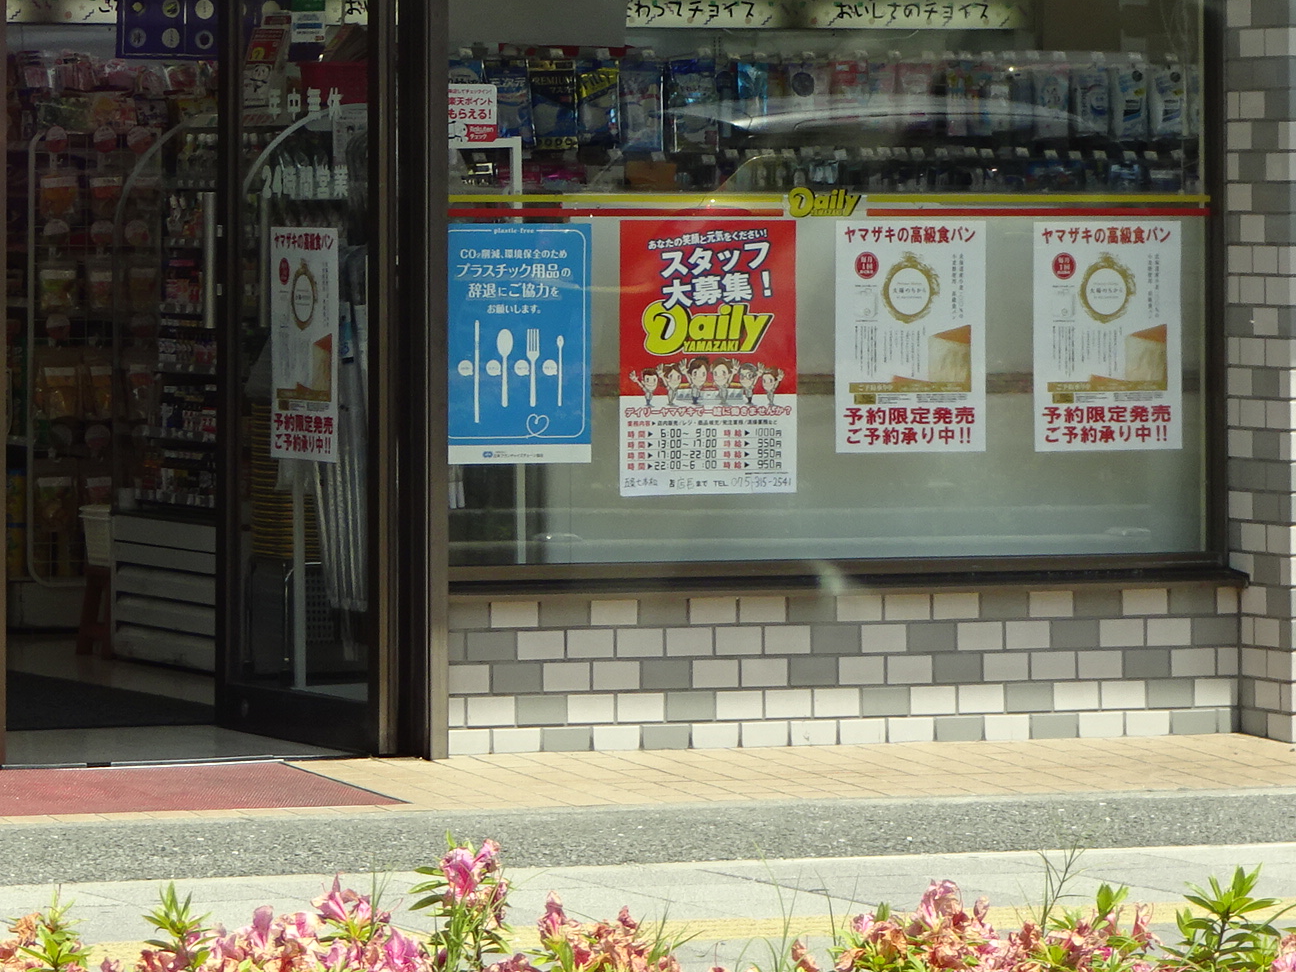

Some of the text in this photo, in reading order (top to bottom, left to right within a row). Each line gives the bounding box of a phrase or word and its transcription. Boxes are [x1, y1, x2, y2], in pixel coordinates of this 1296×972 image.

[788, 187, 861, 218] Daily
[648, 228, 768, 250] あなたの笑顔と元気をください!
[844, 226, 976, 244] ヤマザキの高級食パン
[1042, 227, 1171, 245] ヤマザキの高級食パン
[661, 241, 771, 278] スタッフ
[456, 263, 571, 278] プラスチック用品の
[468, 283, 559, 298] 辞退にご協力を
[487, 304, 542, 314] お願いします。
[642, 301, 775, 355] Daily
[683, 340, 739, 353] YAMAZAKI
[274, 414, 334, 434] 予約限定発売
[844, 406, 975, 425] 予約限定発売
[1042, 405, 1171, 424] 予約限定発売
[846, 427, 971, 445] ご予約承り中!!
[1045, 425, 1167, 444] ご予約承り中!!
